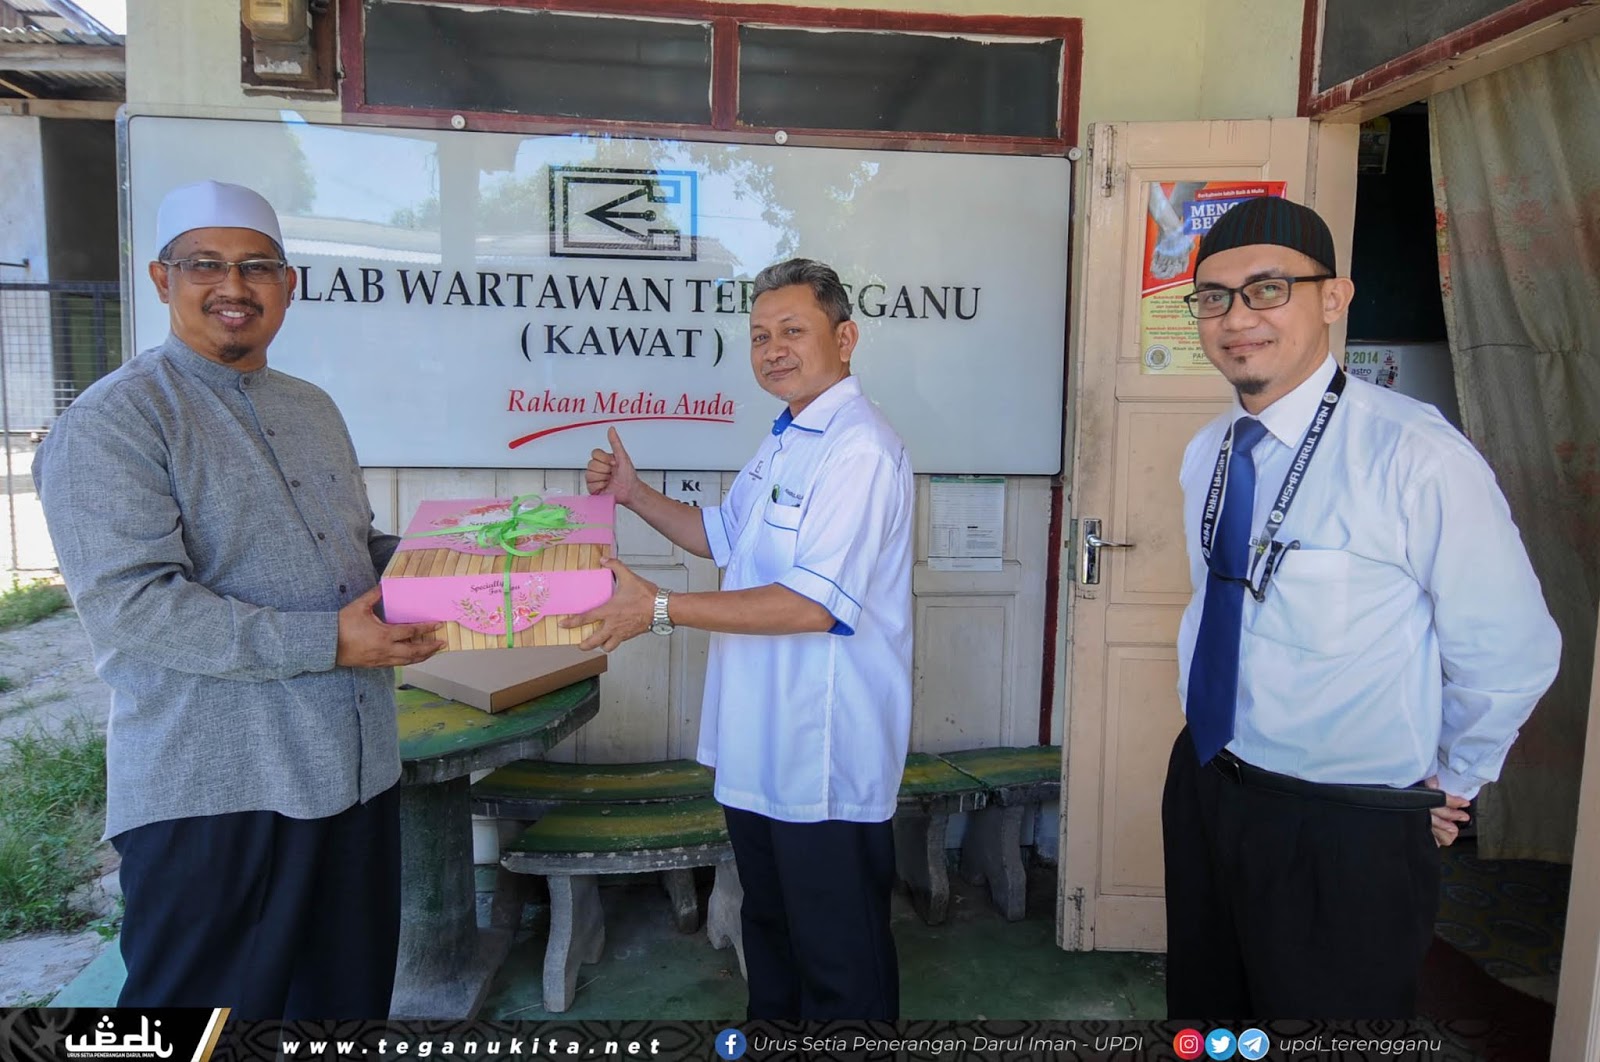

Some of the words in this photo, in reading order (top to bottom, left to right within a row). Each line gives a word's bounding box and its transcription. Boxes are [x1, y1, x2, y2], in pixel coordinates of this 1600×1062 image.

[291, 266, 385, 302] LAB
[396, 269, 672, 312] WARTAWAN
[1351, 367, 1372, 376] astro
[1352, 351, 1378, 364] 2014
[507, 389, 586, 413] Rakan
[592, 391, 667, 415] Media
[672, 392, 734, 416] Anda
[1213, 453, 1226, 488] WISMA
[1278, 472, 1301, 509] WISMA
[1294, 435, 1319, 472] DARUL
[1312, 406, 1330, 438] IMAN
[1204, 488, 1220, 521] DARUL
[1202, 522, 1212, 547] IMAN
